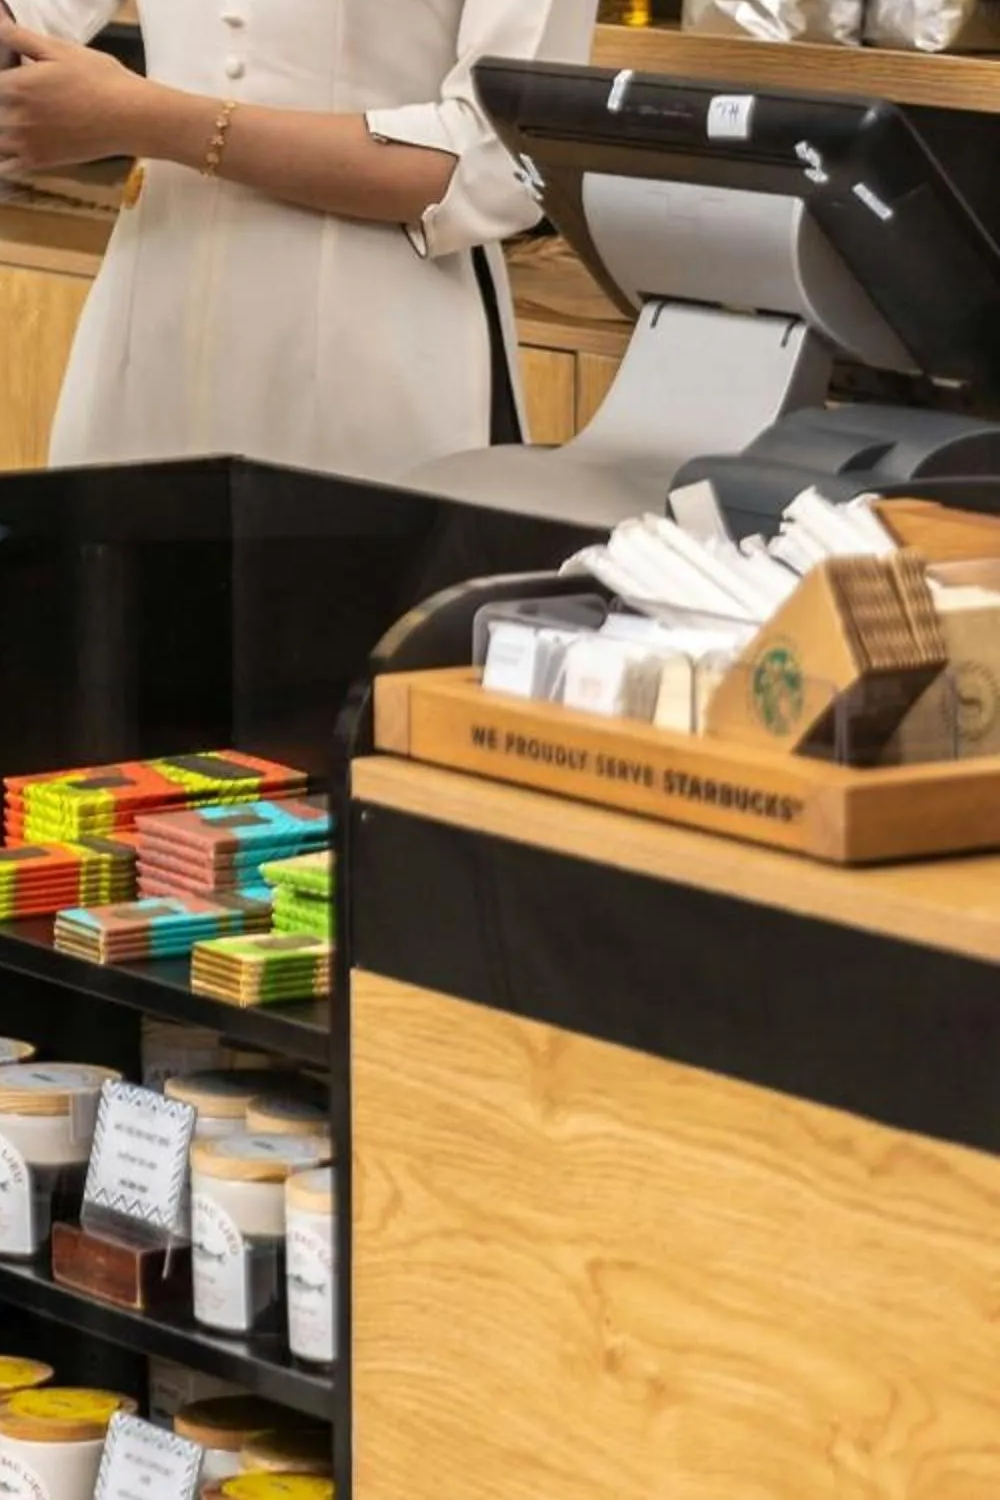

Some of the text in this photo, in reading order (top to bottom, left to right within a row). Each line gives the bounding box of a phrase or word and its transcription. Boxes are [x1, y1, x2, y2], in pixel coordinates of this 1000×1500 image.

[470, 723, 498, 750] WE
[504, 730, 588, 772] PROUDLY
[595, 750, 654, 789] SERVE
